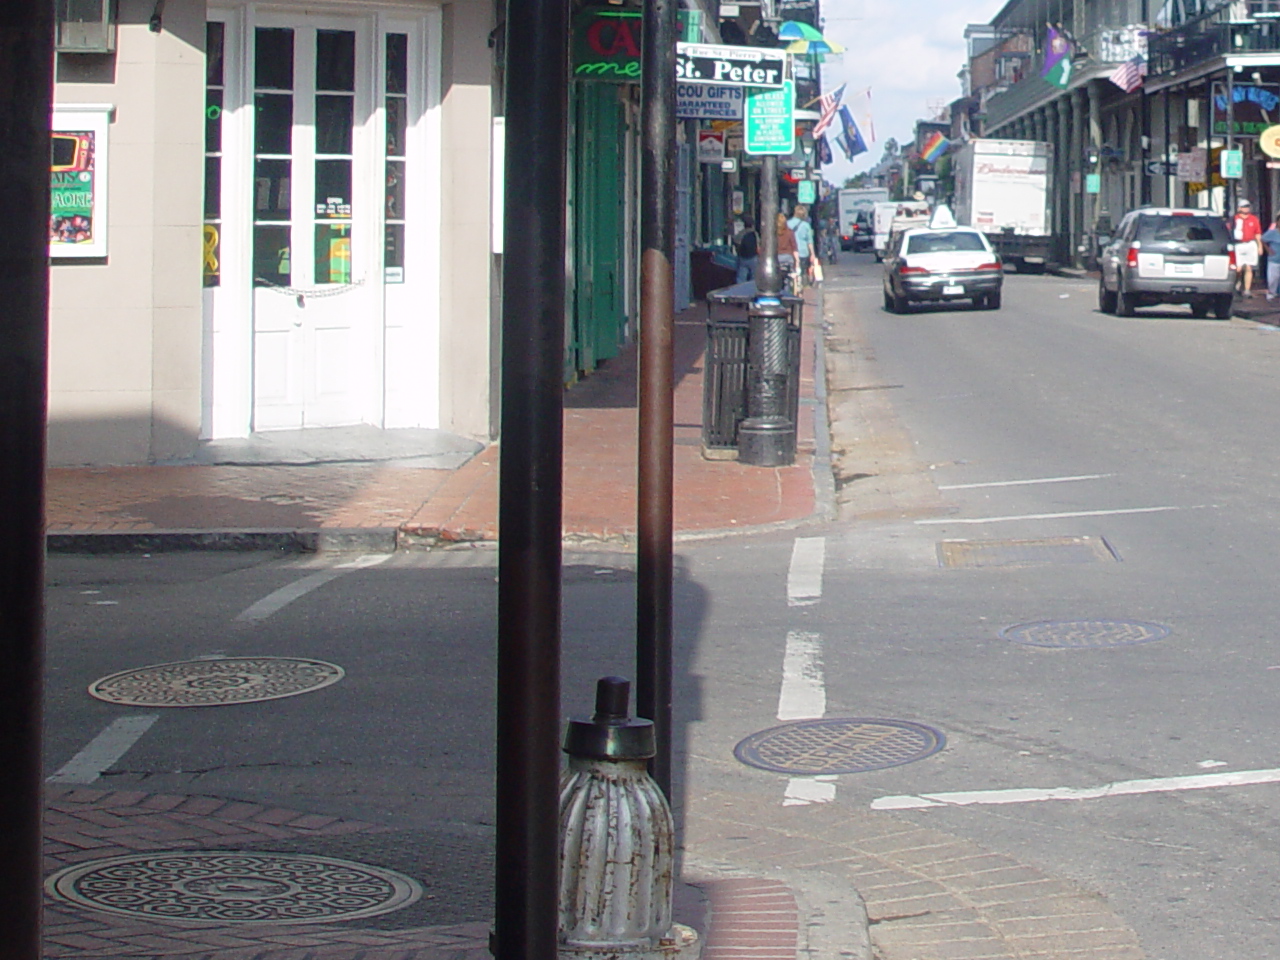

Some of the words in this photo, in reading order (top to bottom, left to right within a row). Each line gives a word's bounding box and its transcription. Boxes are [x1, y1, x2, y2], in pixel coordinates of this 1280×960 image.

[587, 20, 641, 56] CA
[713, 61, 778, 83] Peter
[707, 86, 742, 99] GIFTS
